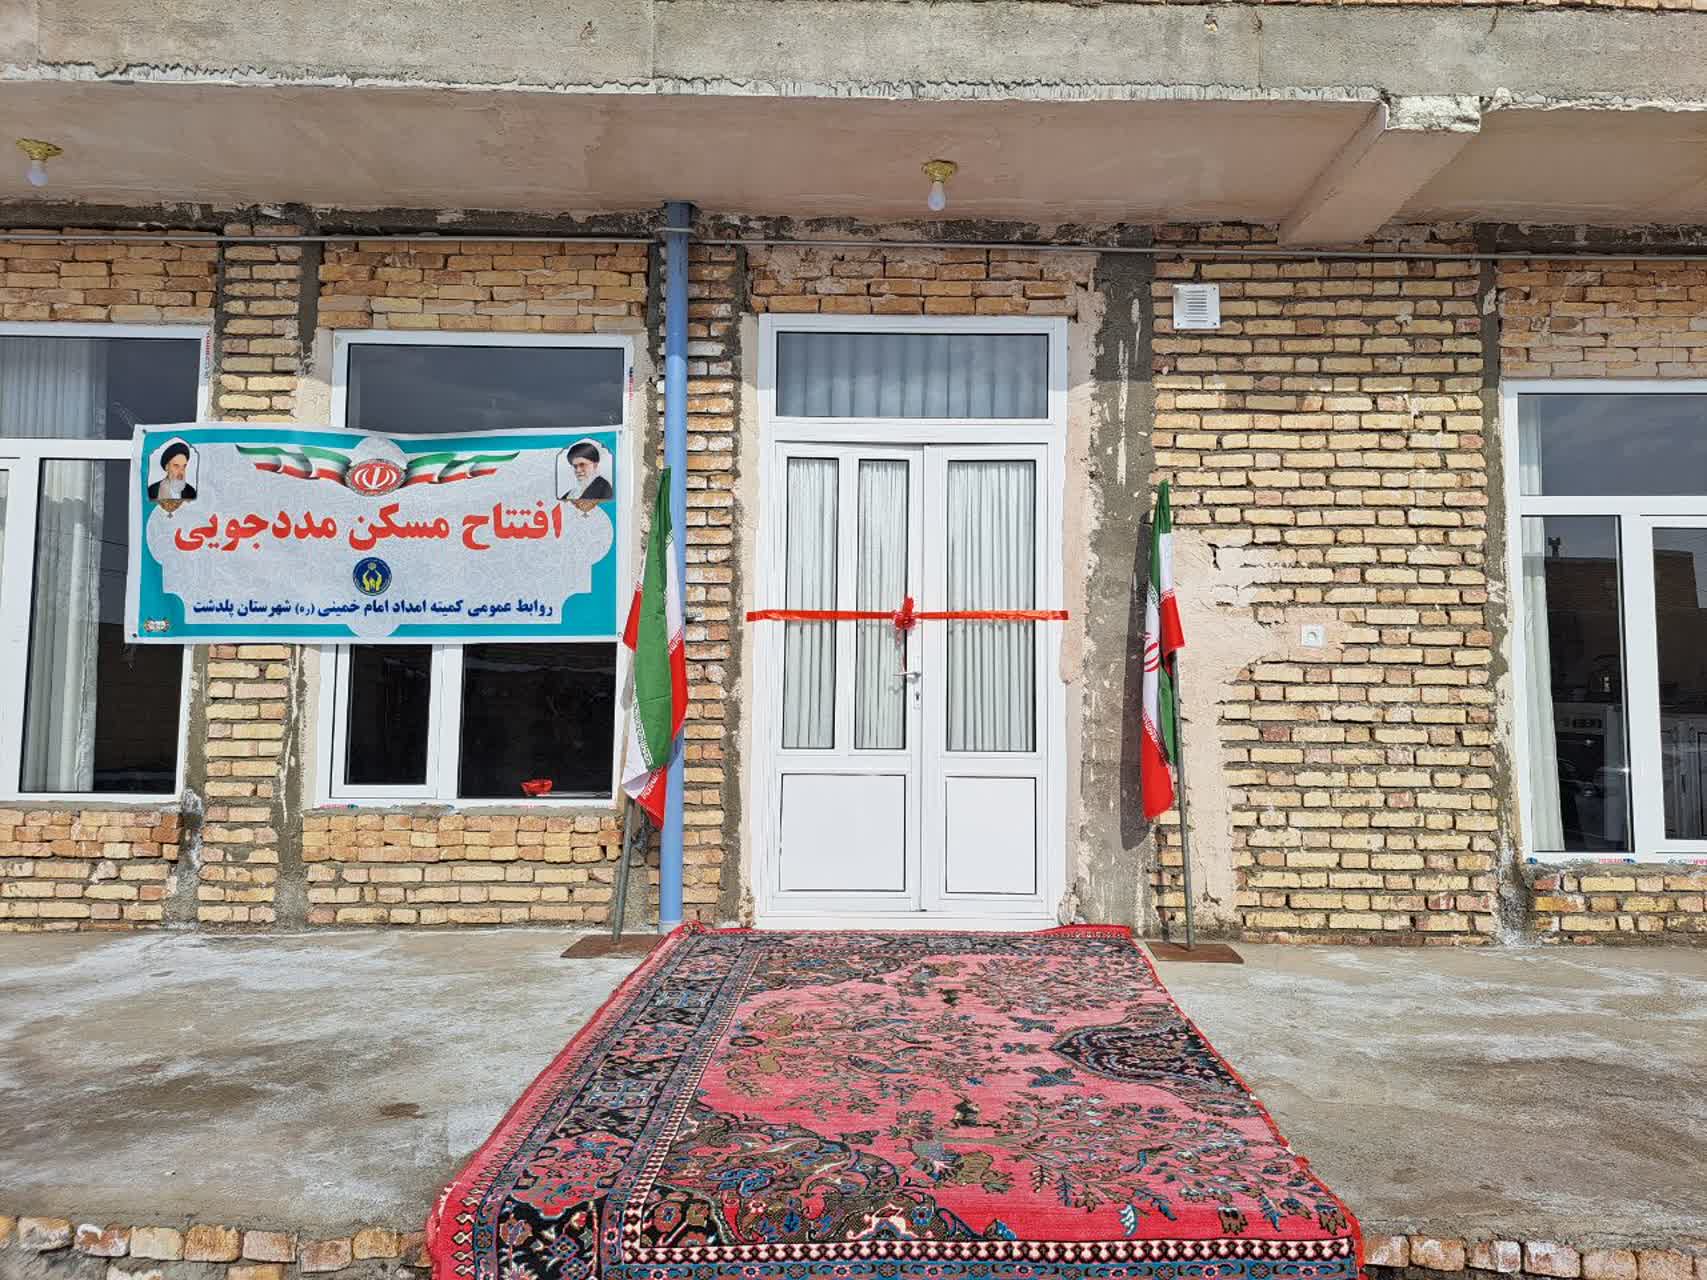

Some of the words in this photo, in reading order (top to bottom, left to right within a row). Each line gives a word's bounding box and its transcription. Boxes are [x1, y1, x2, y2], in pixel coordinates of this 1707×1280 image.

[174, 510, 337, 551] مددجویی
[349, 502, 450, 551] مسکن
[462, 500, 562, 550] افتتاح
[193, 599, 234, 618] پلدشت
[237, 599, 292, 618] شهرستان
[317, 601, 360, 617] خمینی
[363, 600, 389, 616] امام
[392, 600, 426, 613] امداد
[467, 601, 512, 617] عمومی
[516, 600, 553, 616] روابط
